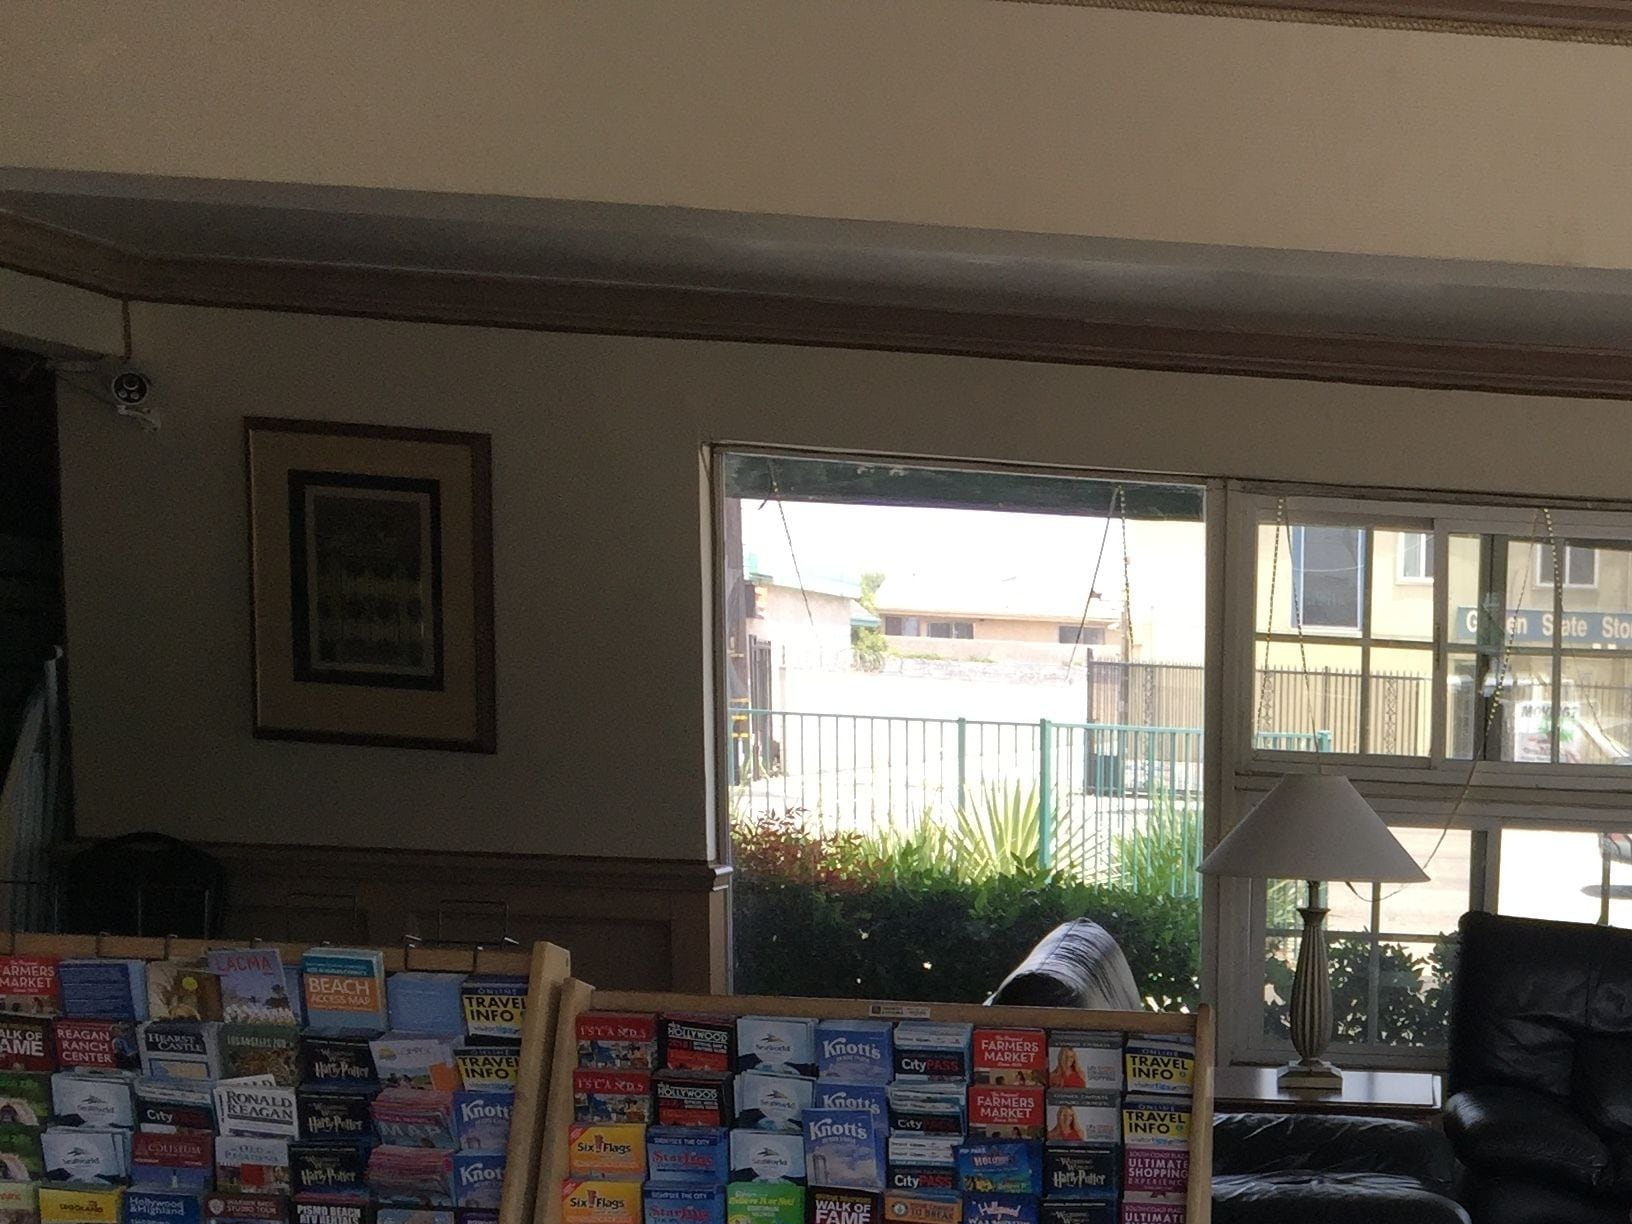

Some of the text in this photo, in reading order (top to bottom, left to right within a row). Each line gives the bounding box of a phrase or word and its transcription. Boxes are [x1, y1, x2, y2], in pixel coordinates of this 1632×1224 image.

[1466, 609, 1527, 635] Gen
[1541, 614, 1588, 637] Sate
[0, 965, 55, 977] ARMERS
[217, 956, 272, 972] LACMA
[308, 976, 370, 995] BEACH
[470, 1009, 514, 1022] INFO
[25, 1031, 43, 1042] OF
[57, 1028, 110, 1041] REAGAN
[149, 1031, 196, 1044] HEARST
[579, 1024, 647, 1039] ISLANDS
[0, 1040, 45, 1057] AME
[62, 1041, 109, 1052] RANCH
[157, 1042, 201, 1052] CASTLE
[823, 1037, 881, 1060] Knott's
[981, 1039, 1039, 1053] FARMERS
[62, 1051, 113, 1064] CENTER
[984, 1051, 1037, 1063] MARKET
[1129, 1055, 1189, 1071] TRAVEL
[315, 1060, 370, 1078] Harry Potter
[463, 1067, 509, 1079] INFO
[901, 1058, 959, 1074] CityPASS
[1132, 1067, 1173, 1081] INFO
[577, 1079, 645, 1092] ISLANDS
[226, 1090, 293, 1108] RONALD
[977, 1096, 1035, 1109] FARMERS
[226, 1103, 294, 1120] REAGAN
[980, 1107, 1033, 1119] MARKET
[1125, 1110, 1186, 1124] TRAVEL
[307, 1116, 364, 1133] Harry Potter
[808, 1118, 867, 1141] Knott's
[1128, 1122, 1171, 1135] INFO
[577, 1141, 632, 1156] Six Flags
[1128, 1158, 1188, 1169] ULTIMATE
[301, 1167, 357, 1186] Harry Potter
[1053, 1169, 1107, 1189] Harry Potter
[1128, 1168, 1188, 1179] SHOPPING
[129, 1196, 184, 1210] Hollywood
[570, 1197, 625, 1210] Six Flags
[815, 1199, 853, 1213] WALK
[854, 1203, 872, 1214] OF
[297, 1204, 360, 1217] PISMO BEACH
[300, 1213, 319, 1224] ATV
